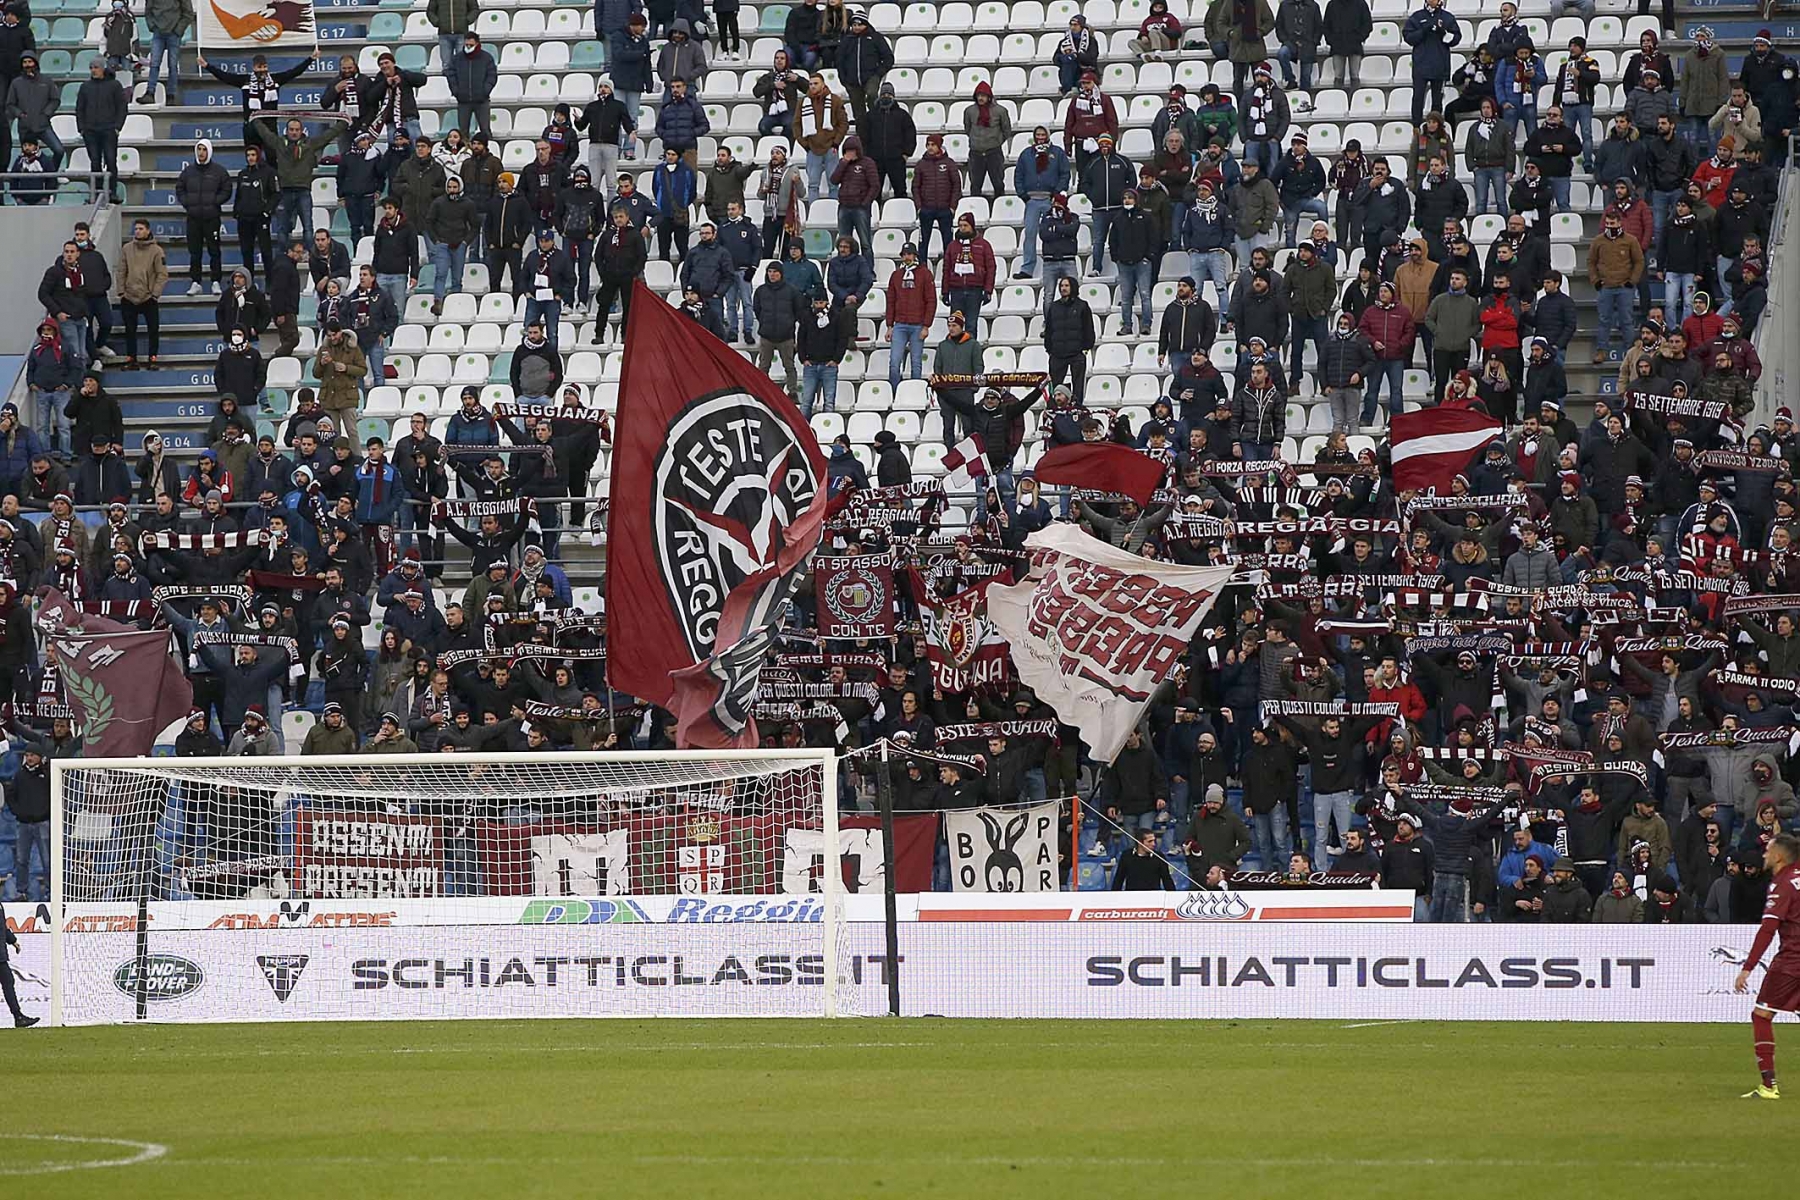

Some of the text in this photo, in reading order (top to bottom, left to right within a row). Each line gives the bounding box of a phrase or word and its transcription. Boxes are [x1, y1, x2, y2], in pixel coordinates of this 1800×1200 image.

[320, 28, 346, 39] G 17
[220, 63, 246, 73] D 16
[321, 60, 334, 71] 16
[208, 95, 233, 105] D 15
[295, 93, 320, 104] G 15
[195, 128, 221, 138] D 14
[191, 374, 199, 385] G
[178, 406, 205, 416] G 05
[1633, 392, 1647, 409] 25
[1648, 395, 1701, 416] SETTEMBRE
[507, 404, 599, 420] REGGIANA
[163, 437, 190, 447] G 04
[679, 417, 763, 501] TESTE
[1215, 461, 1243, 474] FORZA
[1245, 460, 1286, 473] REGGIANA
[469, 499, 521, 516] REGGIANA
[816, 553, 892, 570] A SPASSO
[1674, 574, 1731, 594] SETTEMBRE
[1576, 598, 1592, 608] SE
[830, 624, 886, 637] CON TE
[1725, 671, 1795, 691] PARMA TI ODIO
[758, 685, 774, 699] PER
[775, 684, 804, 699] QUESTI
[842, 683, 852, 697] IO
[526, 698, 565, 719] Teste
[1263, 700, 1281, 715] PER
[1282, 701, 1313, 716] QUESTI
[1664, 725, 1791, 749] Teste Quadre
[1229, 871, 1372, 886] Teste Quadre
[1084, 908, 1169, 920] carburanti
[351, 956, 905, 990] SCHIATTICLASSIT
[1086, 957, 1656, 989] SCHIATTICLASS.IT
